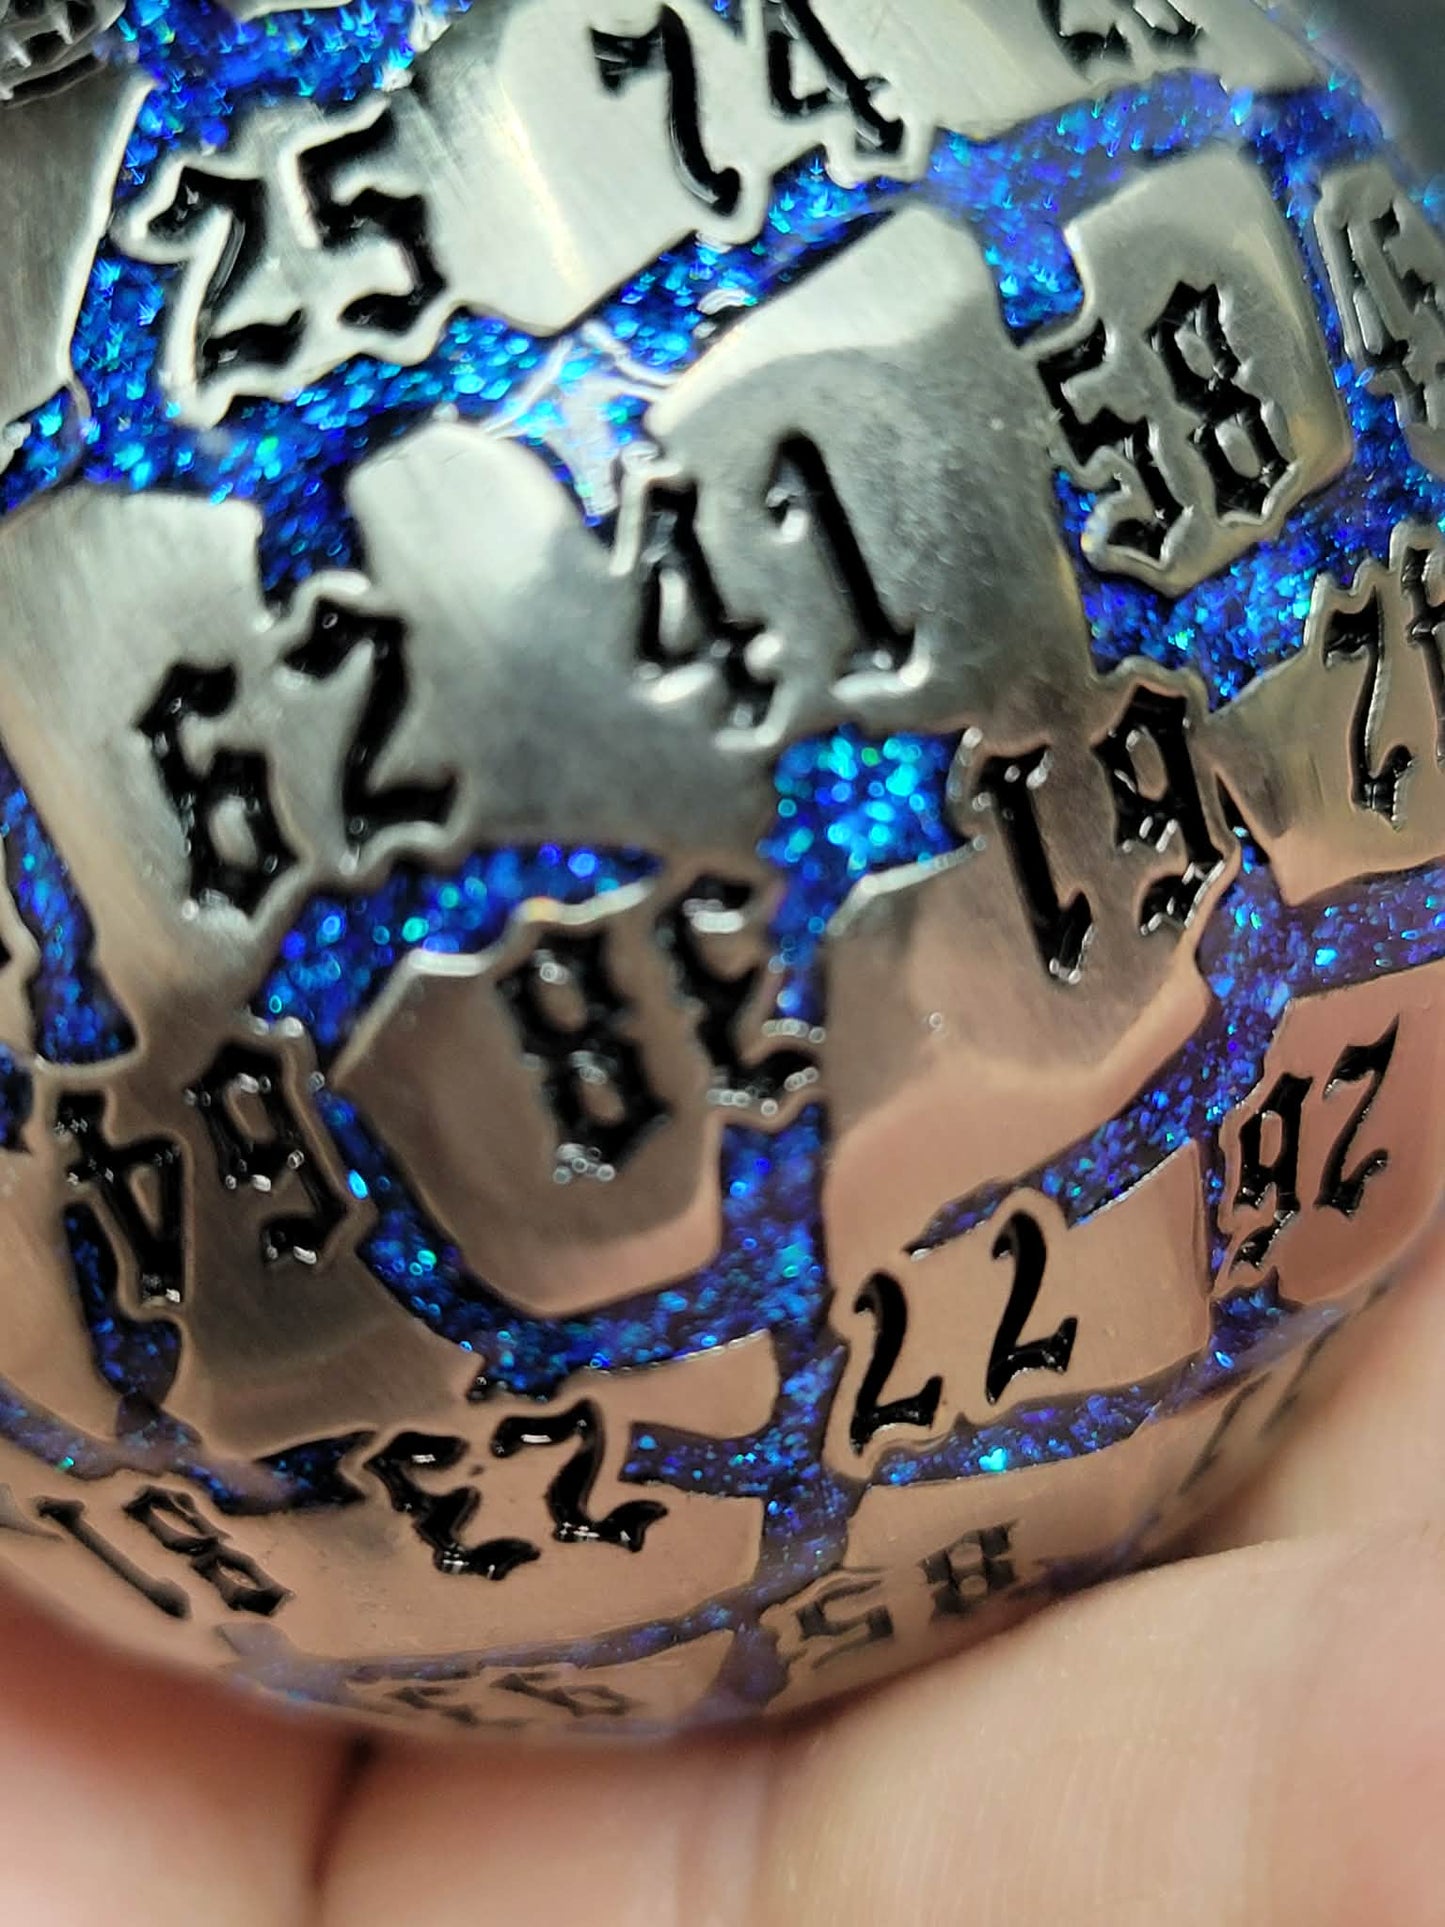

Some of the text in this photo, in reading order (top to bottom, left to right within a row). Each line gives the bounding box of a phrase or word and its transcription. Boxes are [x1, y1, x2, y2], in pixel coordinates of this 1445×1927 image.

[146, 98, 448, 380] 25
[1037, 280, 1297, 564] 58
[634, 432, 926, 738] 41
[133, 598, 459, 919] 62
[849, 1210, 1079, 1457] 22
